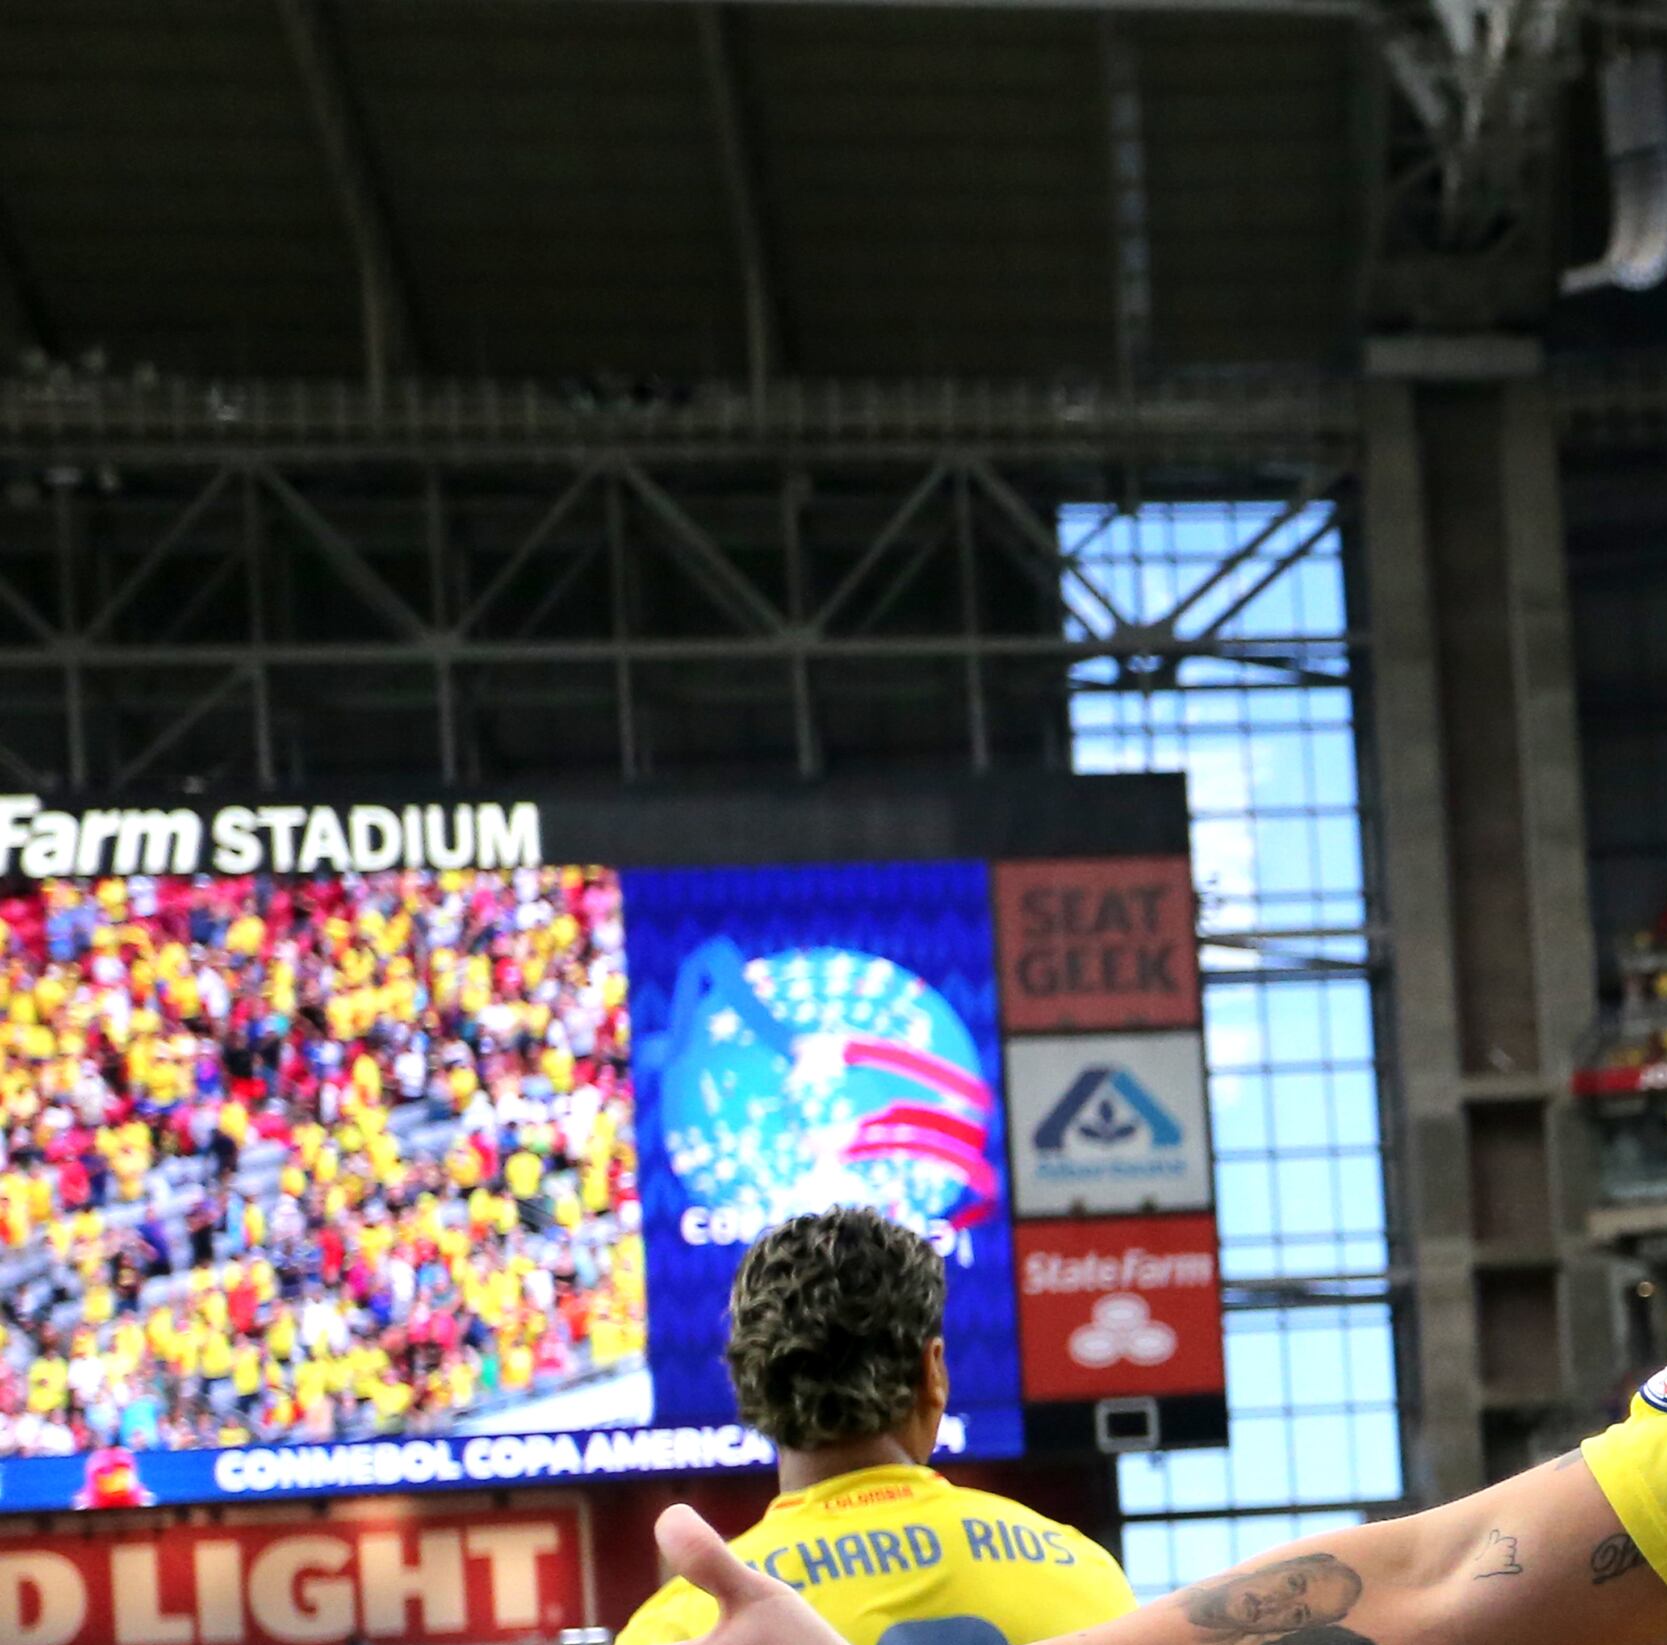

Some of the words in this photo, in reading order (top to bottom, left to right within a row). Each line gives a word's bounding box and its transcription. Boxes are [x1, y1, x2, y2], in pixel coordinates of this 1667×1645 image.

[0, 794, 203, 878] Farm
[212, 799, 545, 877] STADIUM
[1018, 884, 1166, 940] SEAT
[1016, 940, 1180, 997] GEEK
[1023, 1251, 1122, 1295] State
[1121, 1247, 1215, 1289] Farm
[215, 1438, 463, 1493] CONMEBOL
[463, 1430, 580, 1482] COPA
[579, 1422, 776, 1474] AMERICA
[746, 1524, 942, 1592] CHARD
[962, 1517, 1077, 1567] RIOS
